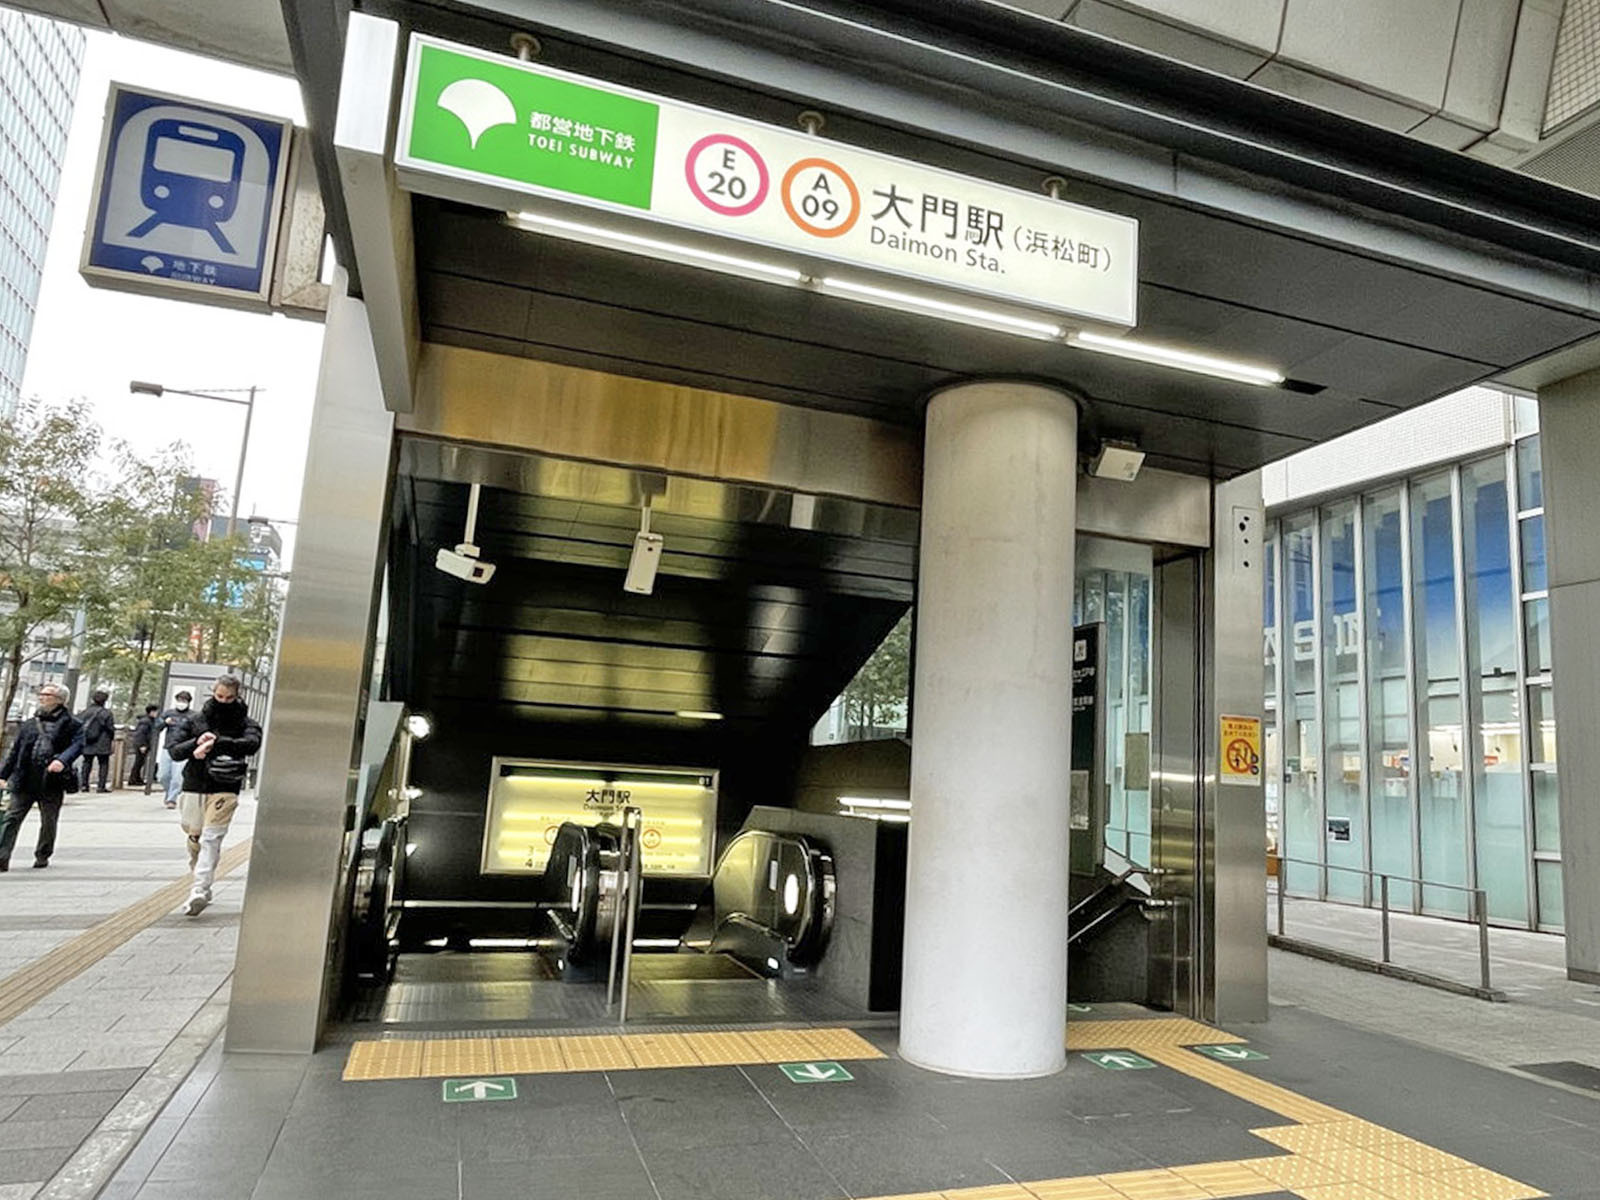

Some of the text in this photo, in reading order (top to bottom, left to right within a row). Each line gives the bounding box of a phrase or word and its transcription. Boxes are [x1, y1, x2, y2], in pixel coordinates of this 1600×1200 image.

[530, 111, 635, 152] 都営地下鉄
[528, 133, 635, 169] TOEI SUBWAY
[722, 148, 736, 171] E
[707, 171, 747, 200] 20
[812, 172, 832, 195] A
[801, 194, 840, 221] 09
[871, 184, 1004, 251] 大門駅
[870, 226, 1006, 274] Daimon Sta.
[173, 260, 216, 276] 地下鉄
[585, 789, 631, 804] 大門駅
